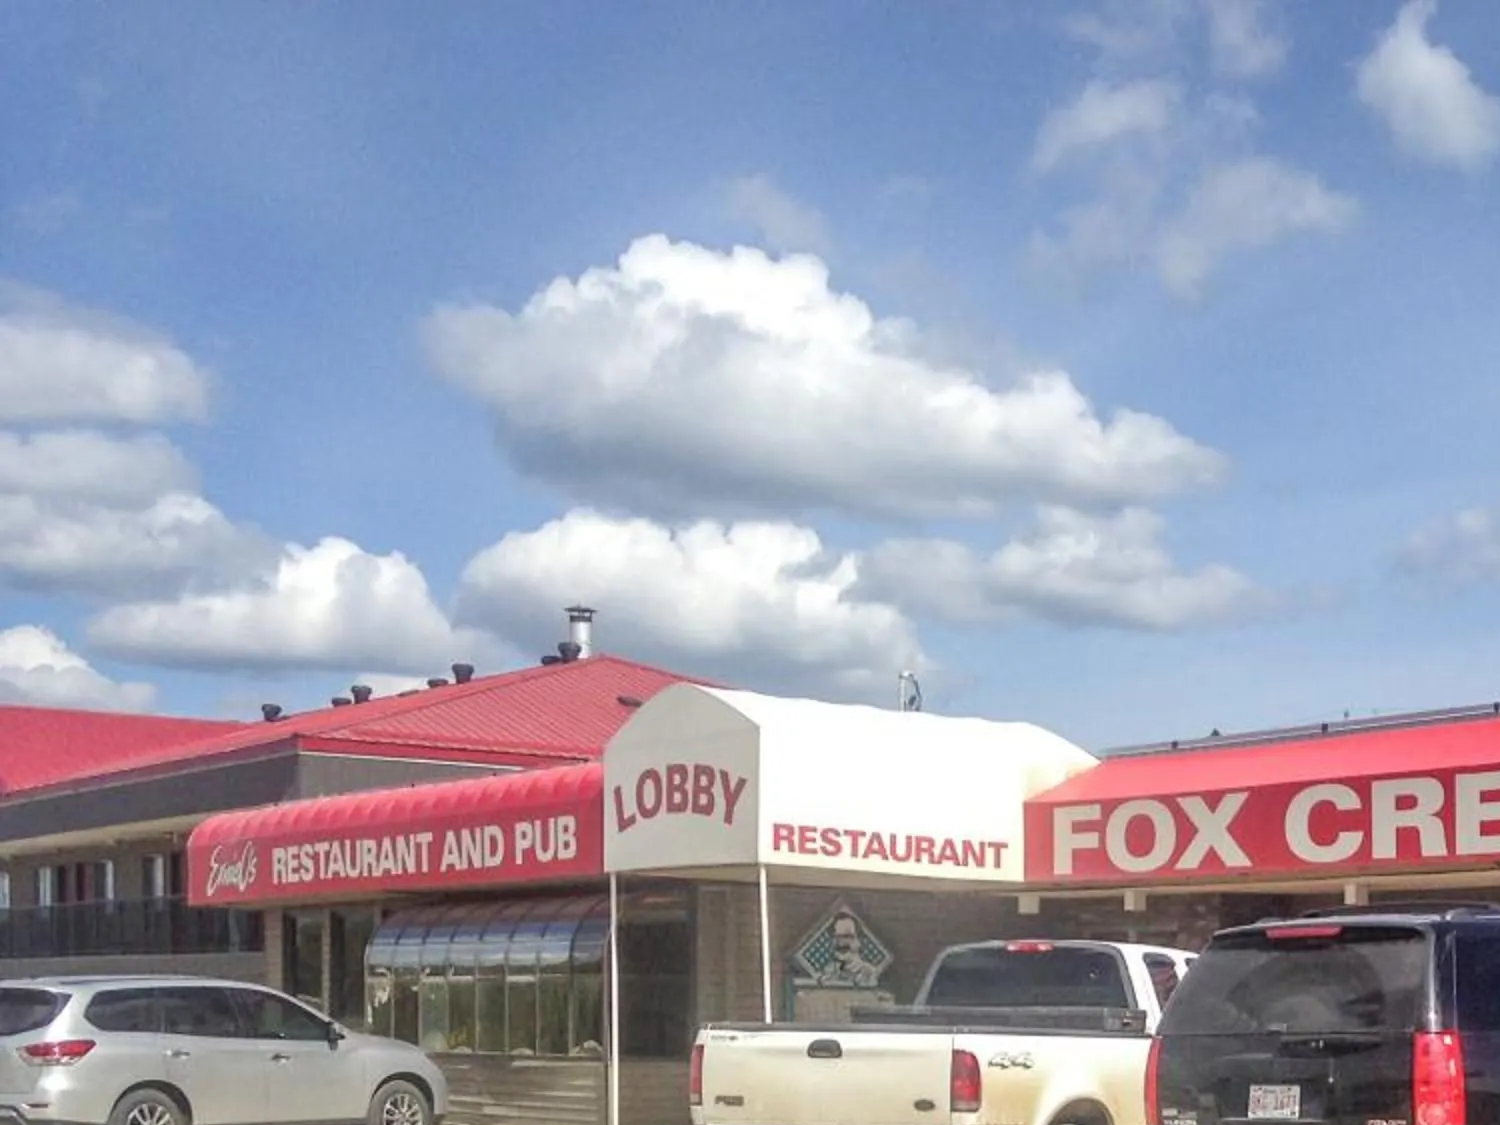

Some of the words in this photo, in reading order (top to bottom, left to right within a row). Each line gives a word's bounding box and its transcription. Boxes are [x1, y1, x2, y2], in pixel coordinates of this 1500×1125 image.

[613, 763, 748, 833] LOBBY
[1052, 790, 1253, 876] FOX
[272, 831, 433, 885] RESTAURANT
[440, 824, 506, 873] AND
[515, 815, 577, 865] PUB
[772, 822, 1009, 870] RESTAURANT
